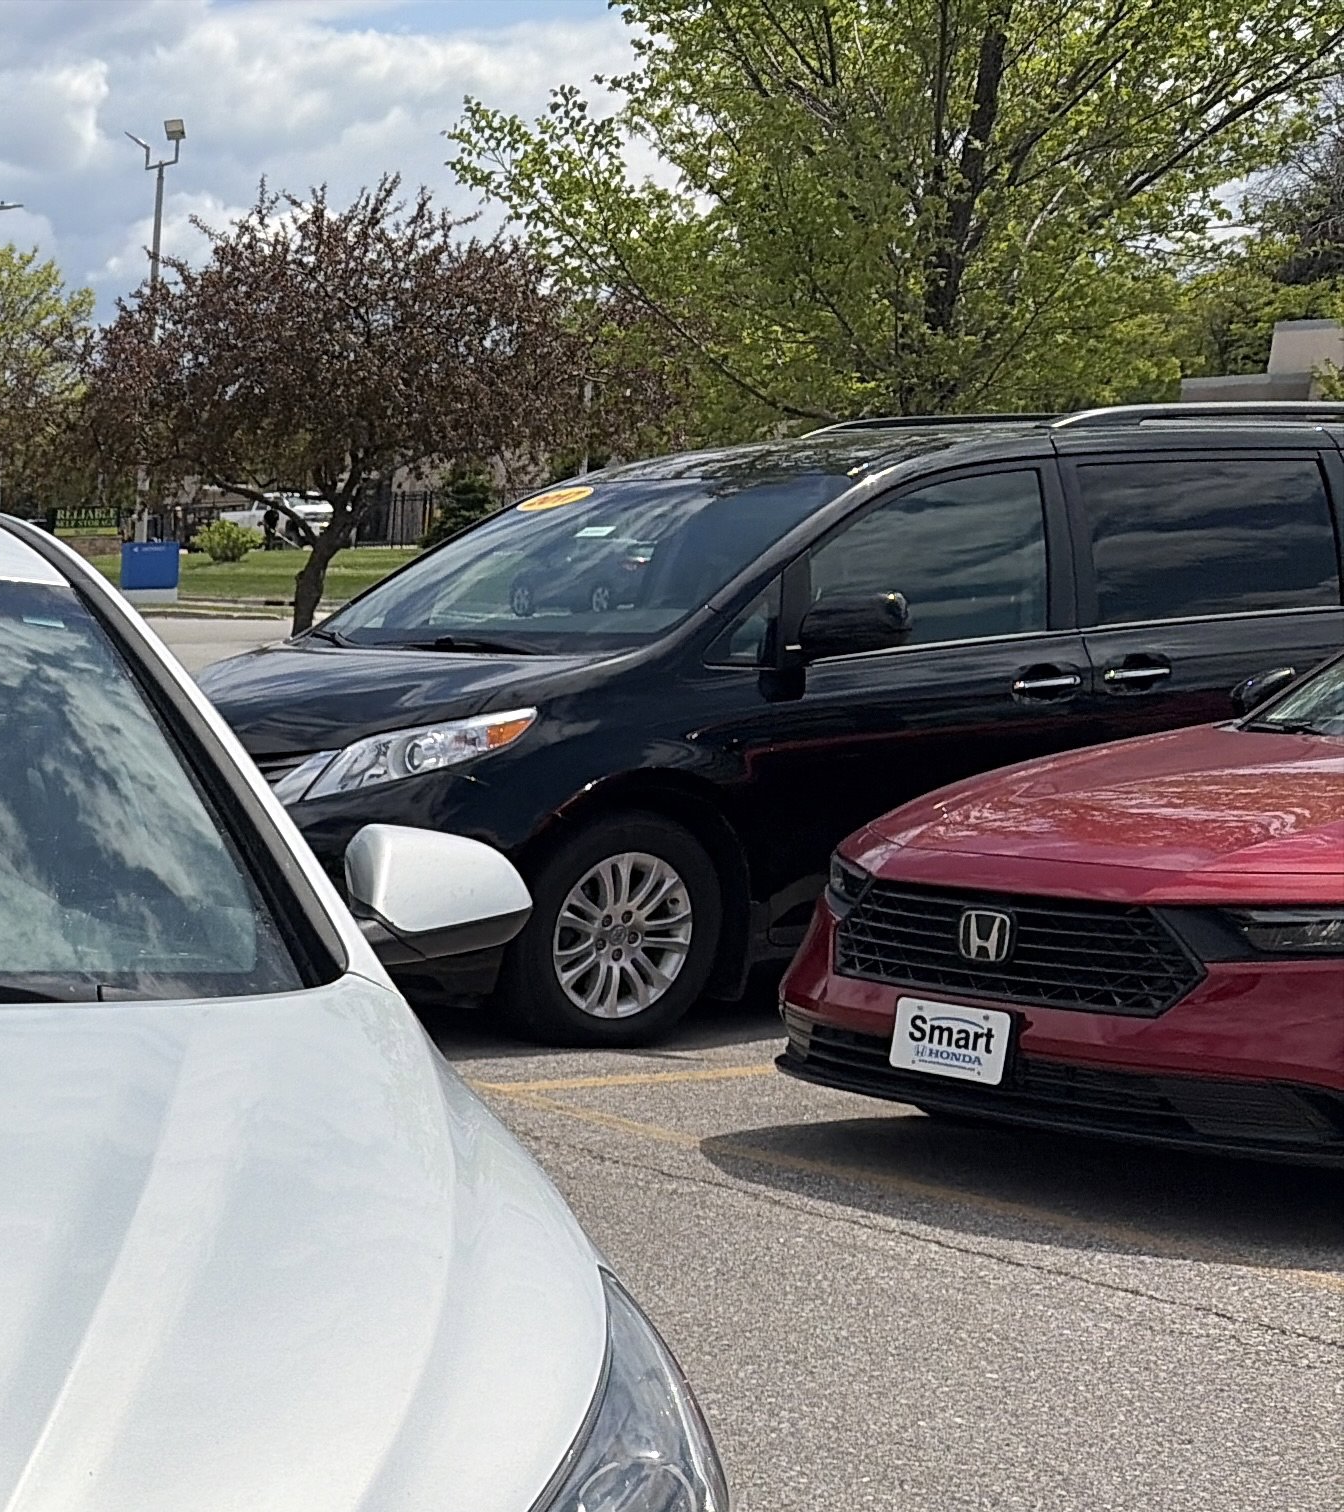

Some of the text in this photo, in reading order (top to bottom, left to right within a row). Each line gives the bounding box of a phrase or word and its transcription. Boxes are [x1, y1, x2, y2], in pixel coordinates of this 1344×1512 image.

[57, 508, 117, 519] RELIABLE
[55, 519, 116, 527] SELF STORAGE
[908, 1014, 995, 1054] Smart
[928, 1048, 983, 1066] HONDA
